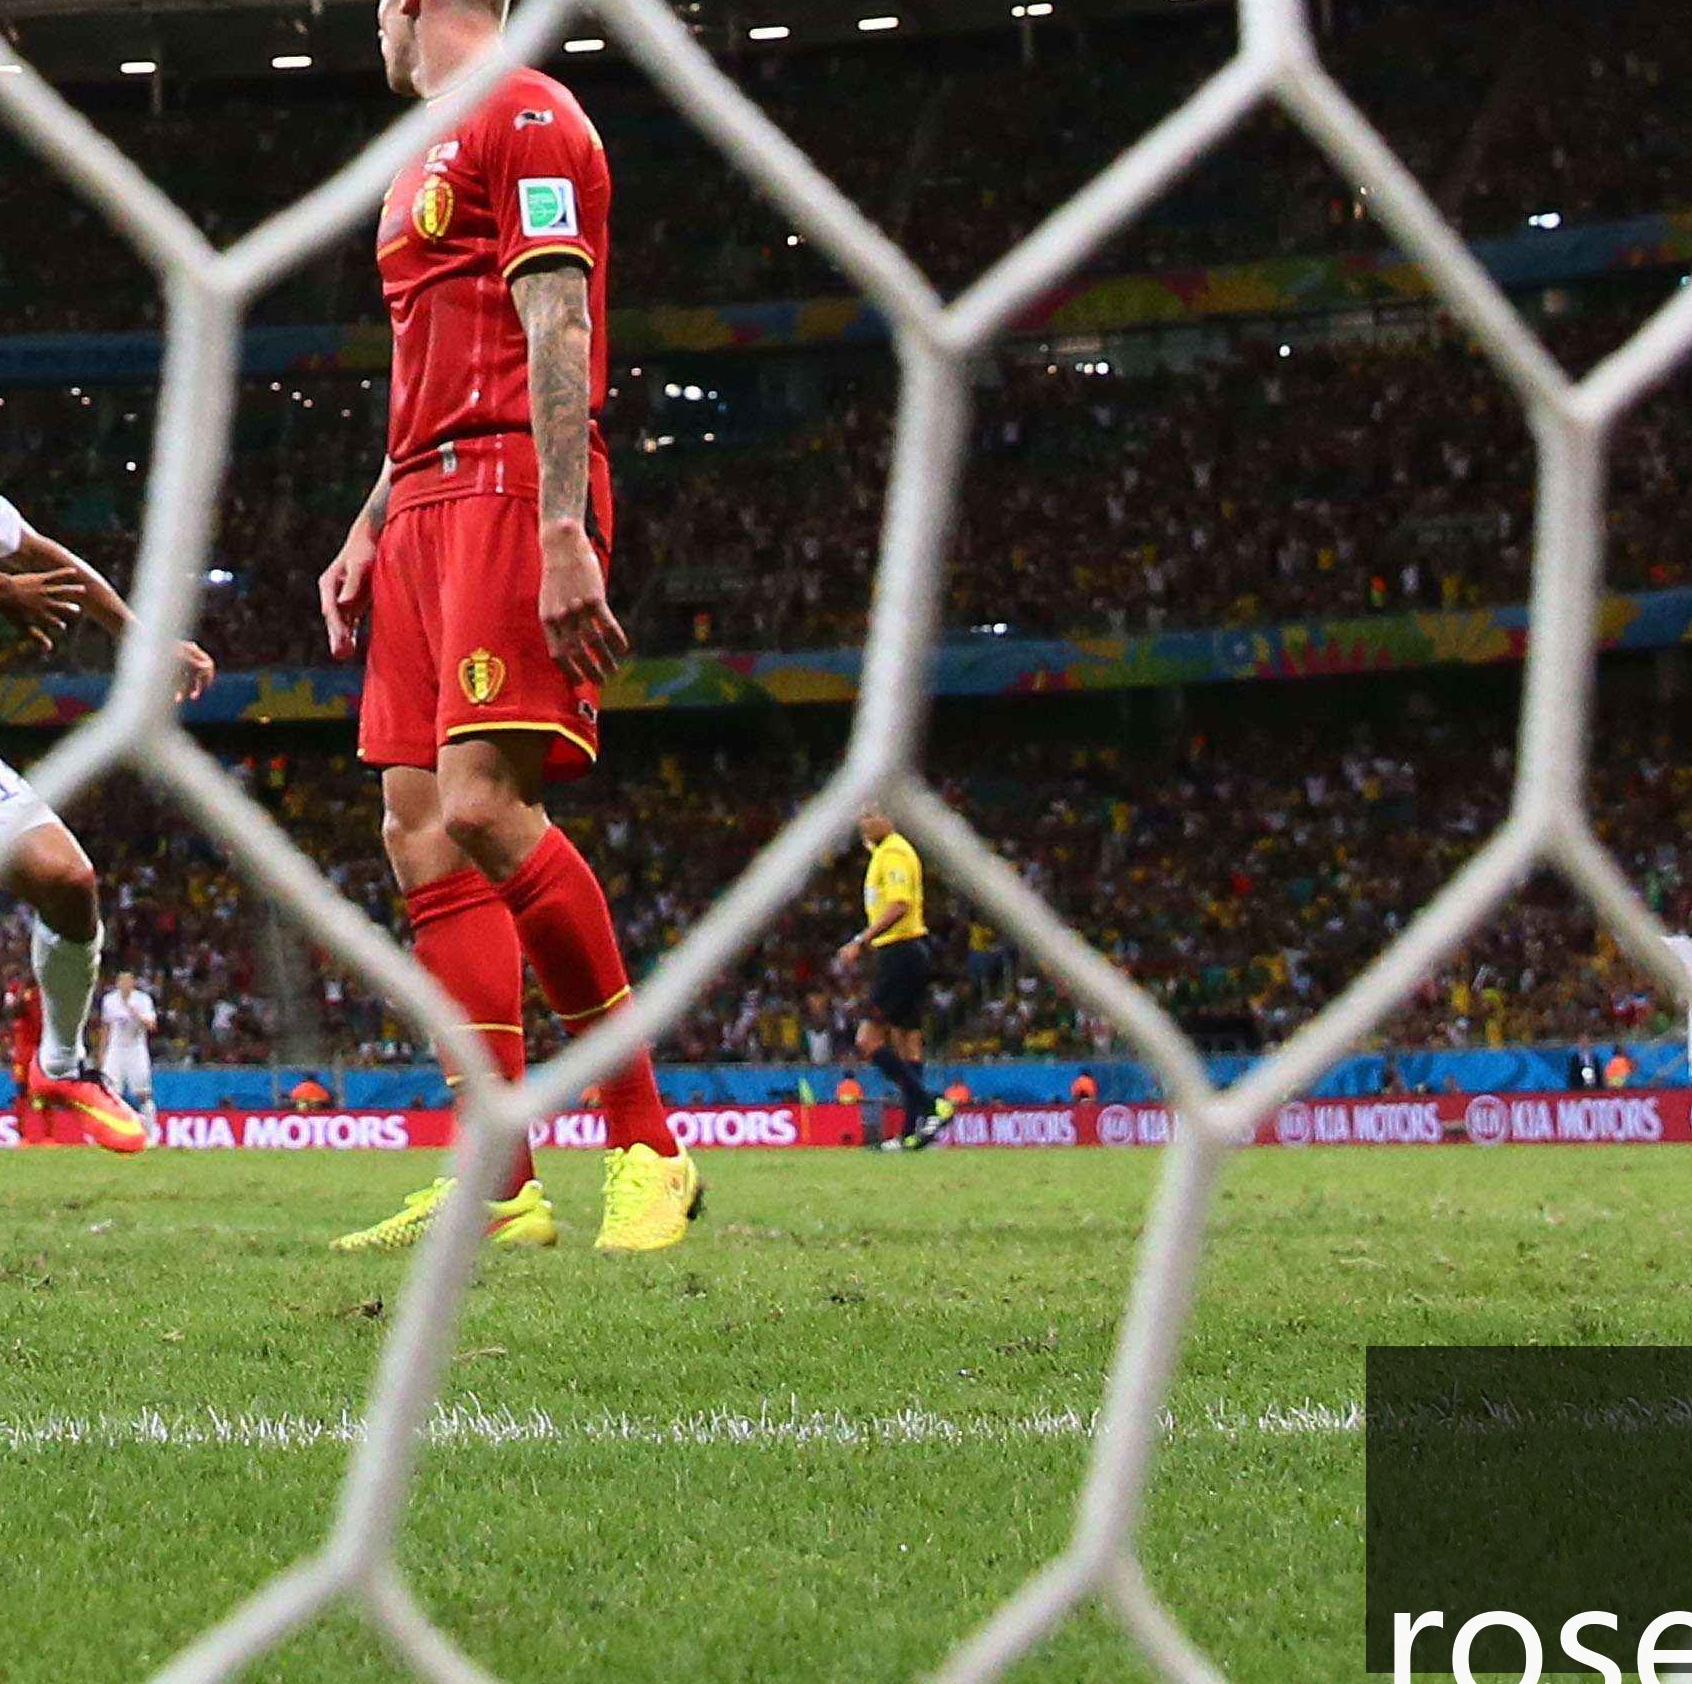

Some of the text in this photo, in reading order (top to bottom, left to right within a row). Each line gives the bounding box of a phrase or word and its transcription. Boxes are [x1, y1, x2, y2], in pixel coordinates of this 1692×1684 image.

[166, 1114, 410, 1149] KIA MOTORS
[666, 1109, 798, 1146] OTORS
